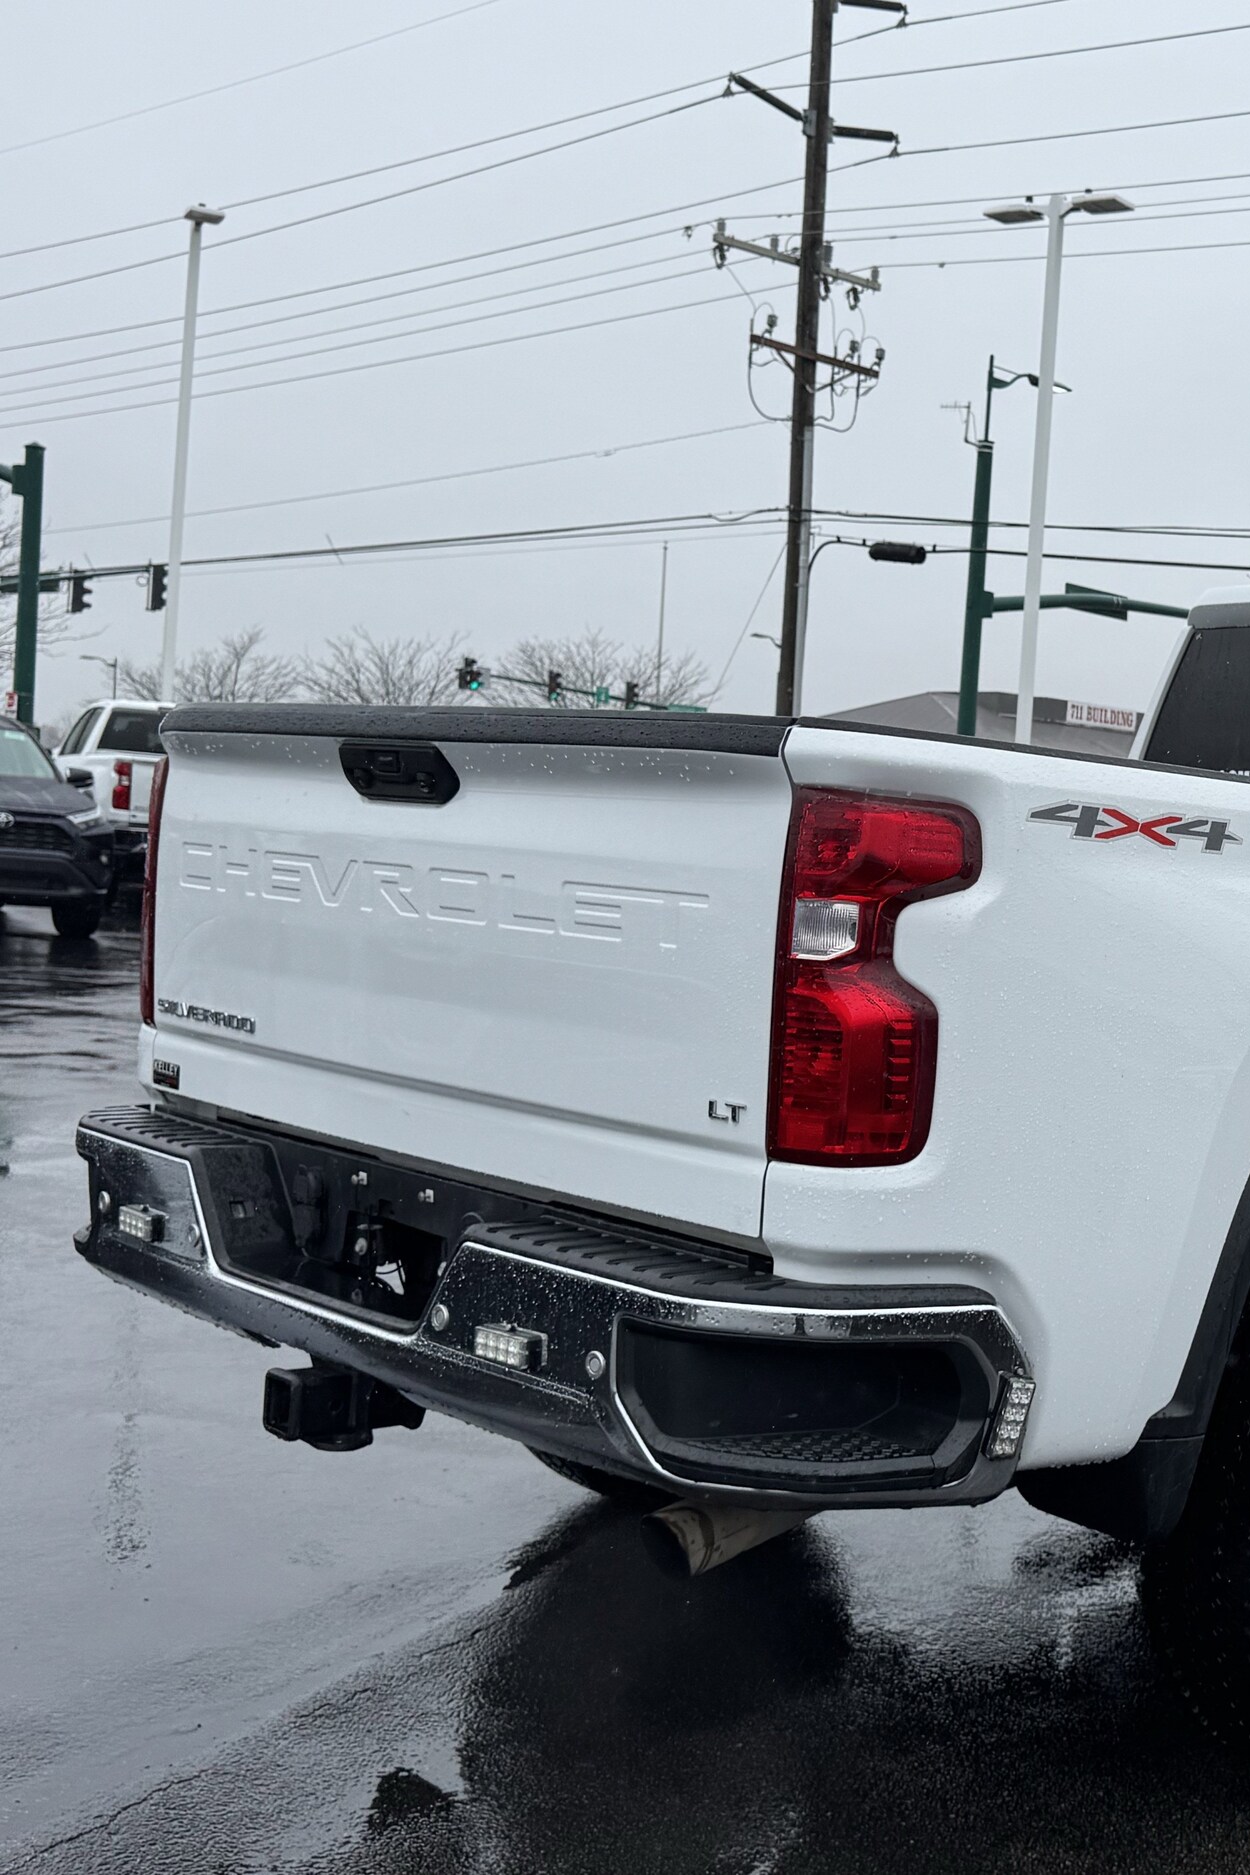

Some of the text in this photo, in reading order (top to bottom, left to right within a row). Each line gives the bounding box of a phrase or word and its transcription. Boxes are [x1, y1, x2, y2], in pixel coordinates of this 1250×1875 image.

[1070, 703, 1133, 728] 711 BUILDING
[1028, 802, 1243, 853] 4X4
[180, 841, 710, 948] CHEVROLET
[158, 998, 255, 1034] SILVERADO
[154, 1060, 179, 1076] KELLEY
[708, 1100, 748, 1124] LT
